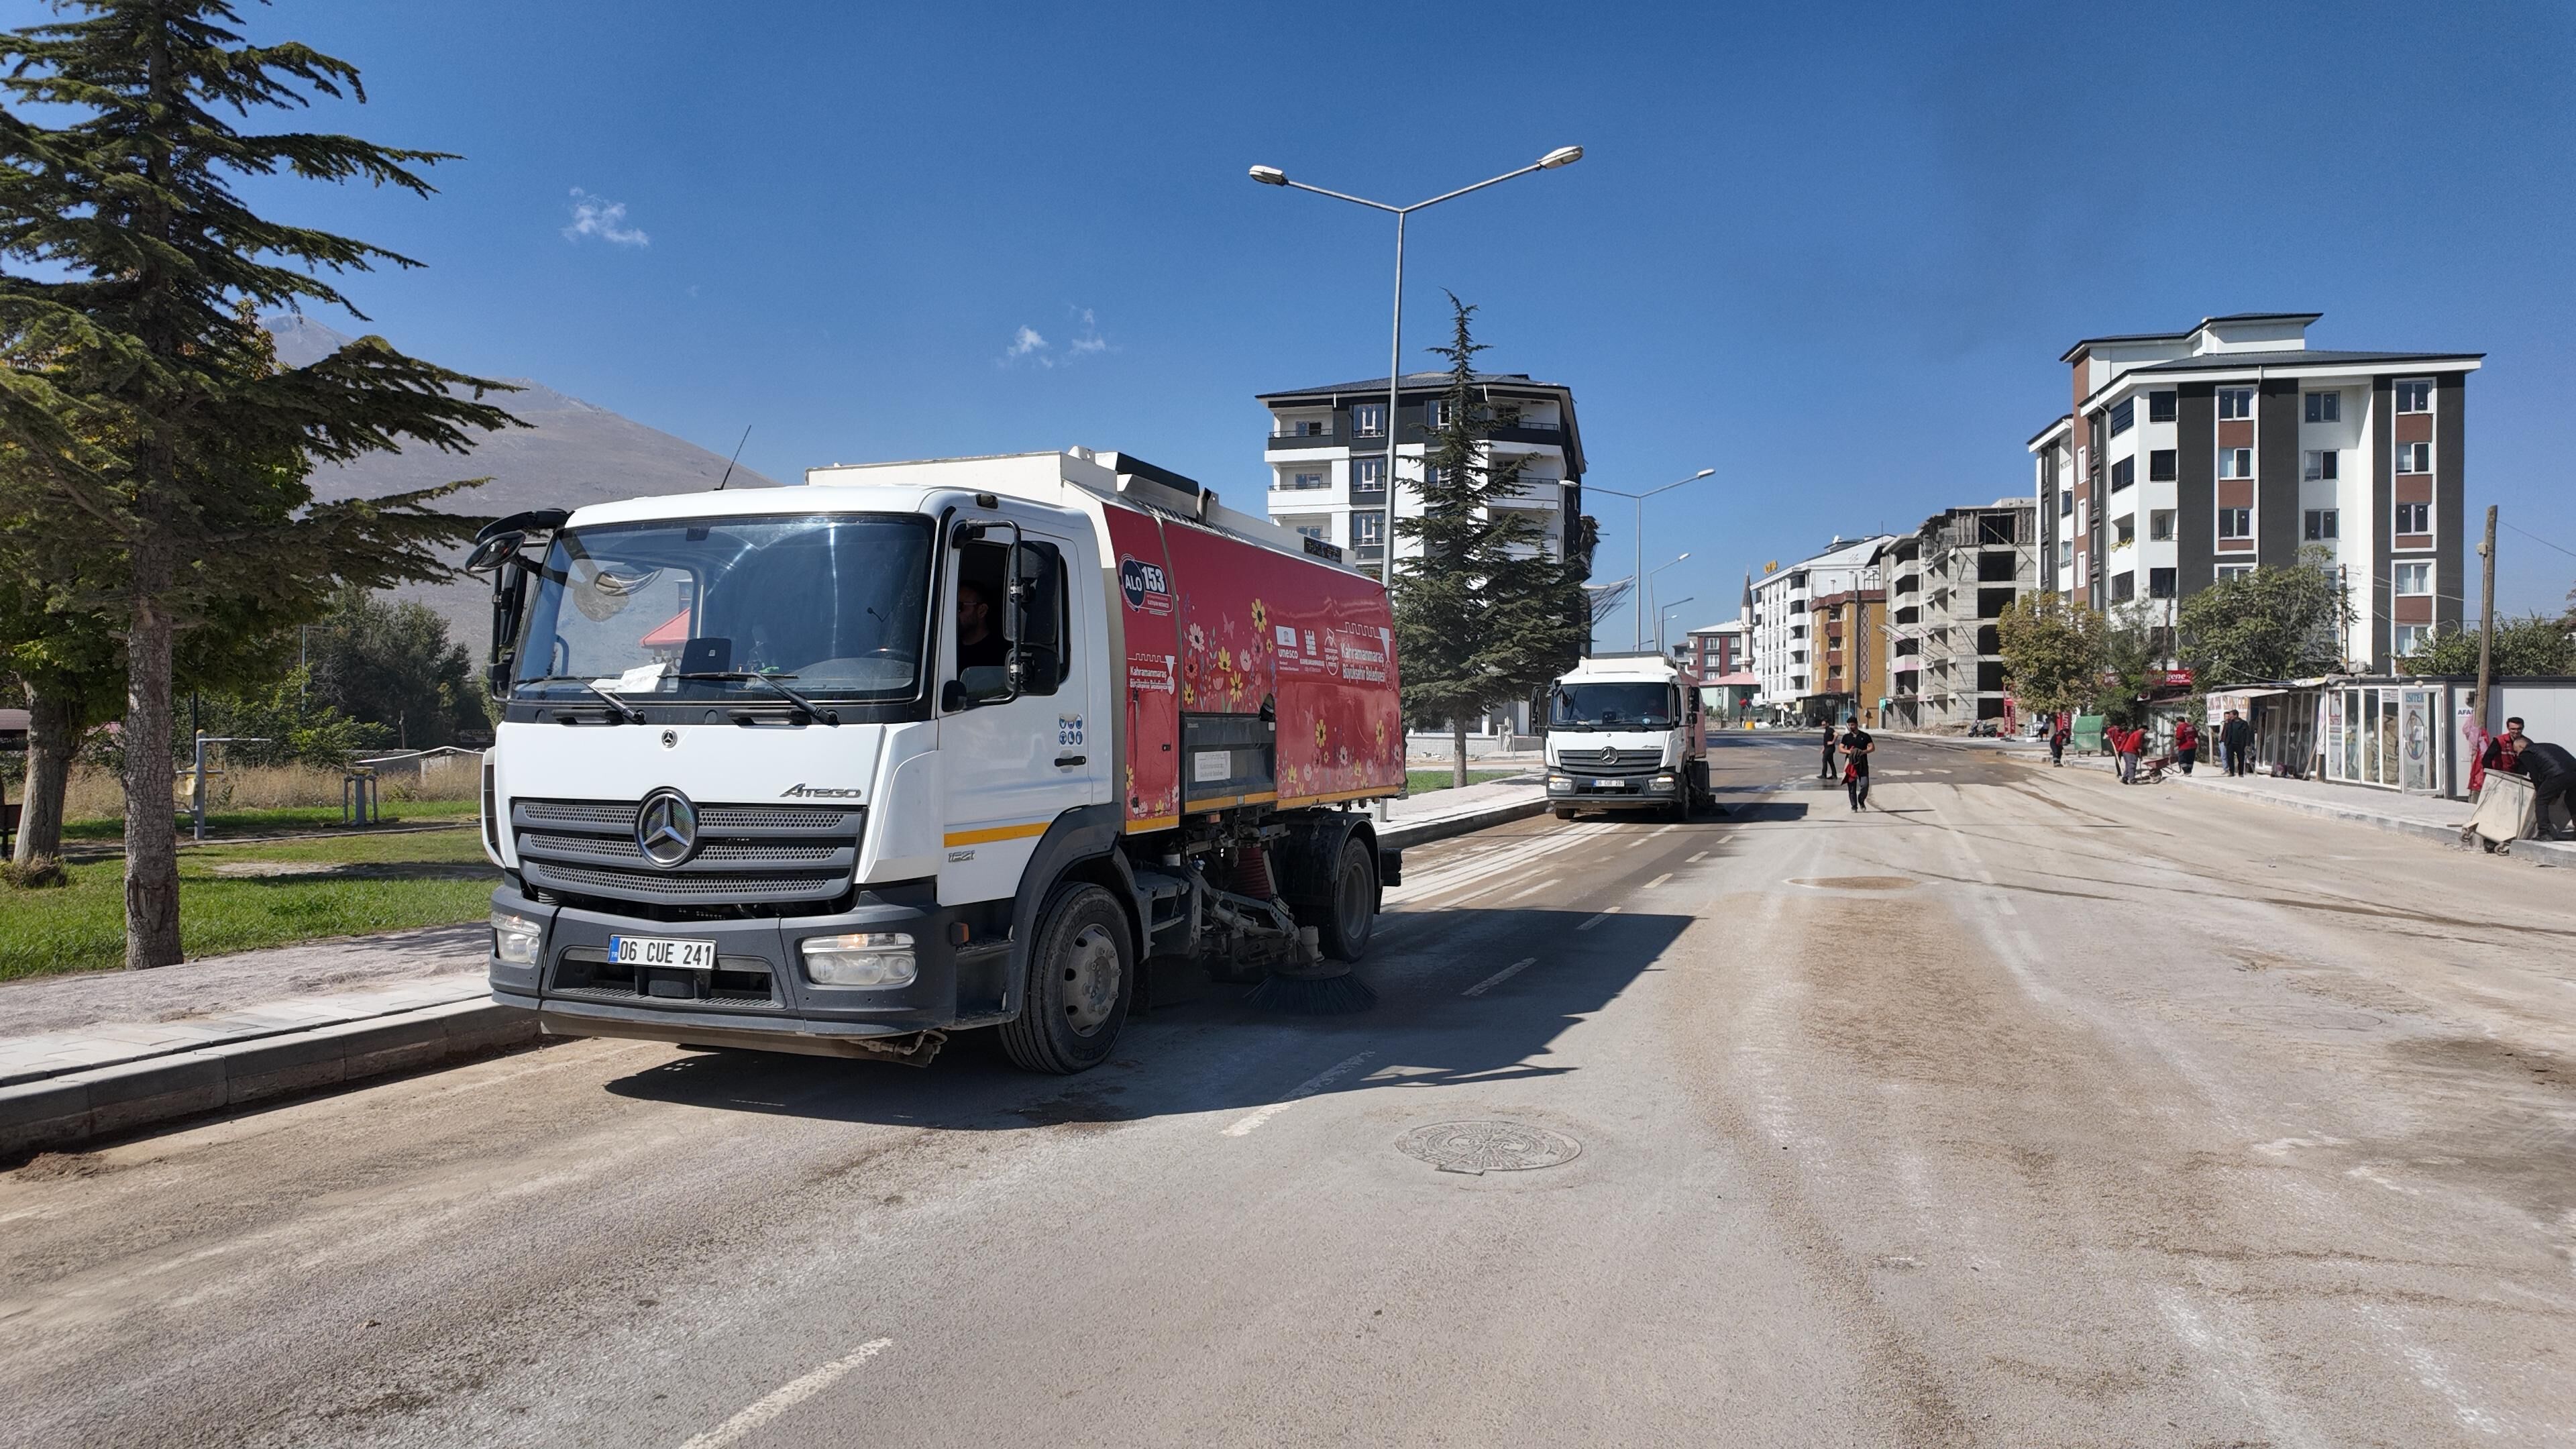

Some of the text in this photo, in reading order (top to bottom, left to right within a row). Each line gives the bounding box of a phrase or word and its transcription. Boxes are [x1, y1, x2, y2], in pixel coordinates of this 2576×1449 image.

[1125, 574, 1142, 592] ALO
[1141, 566, 1165, 593] 153
[1277, 648, 1299, 659] unesco
[1340, 643, 1385, 667] Kahramanmaraş
[1342, 663, 1366, 684] Büyükşehir
[779, 782, 862, 798] ATEGO
[620, 941, 638, 961] 06
[647, 942, 675, 964] CUE
[682, 944, 712, 966] 241
